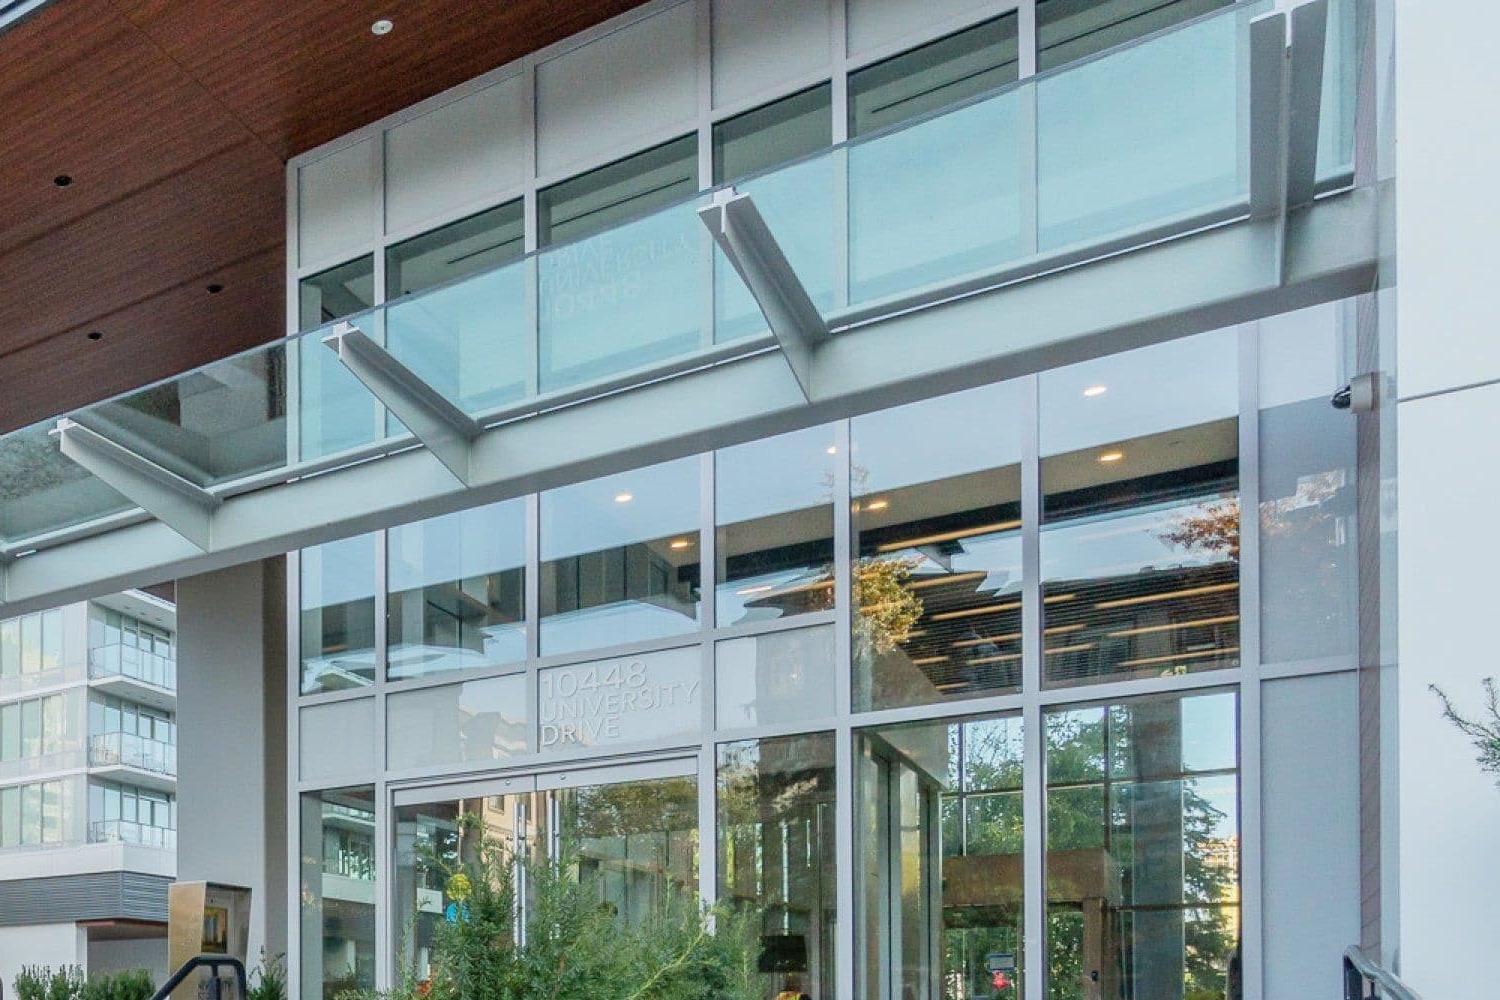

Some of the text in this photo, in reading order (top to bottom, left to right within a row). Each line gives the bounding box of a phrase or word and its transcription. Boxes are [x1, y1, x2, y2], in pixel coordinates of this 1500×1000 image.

[542, 660, 648, 699] 10448
[541, 680, 699, 722] UNIVERSITY
[541, 716, 620, 746] DRIVE
